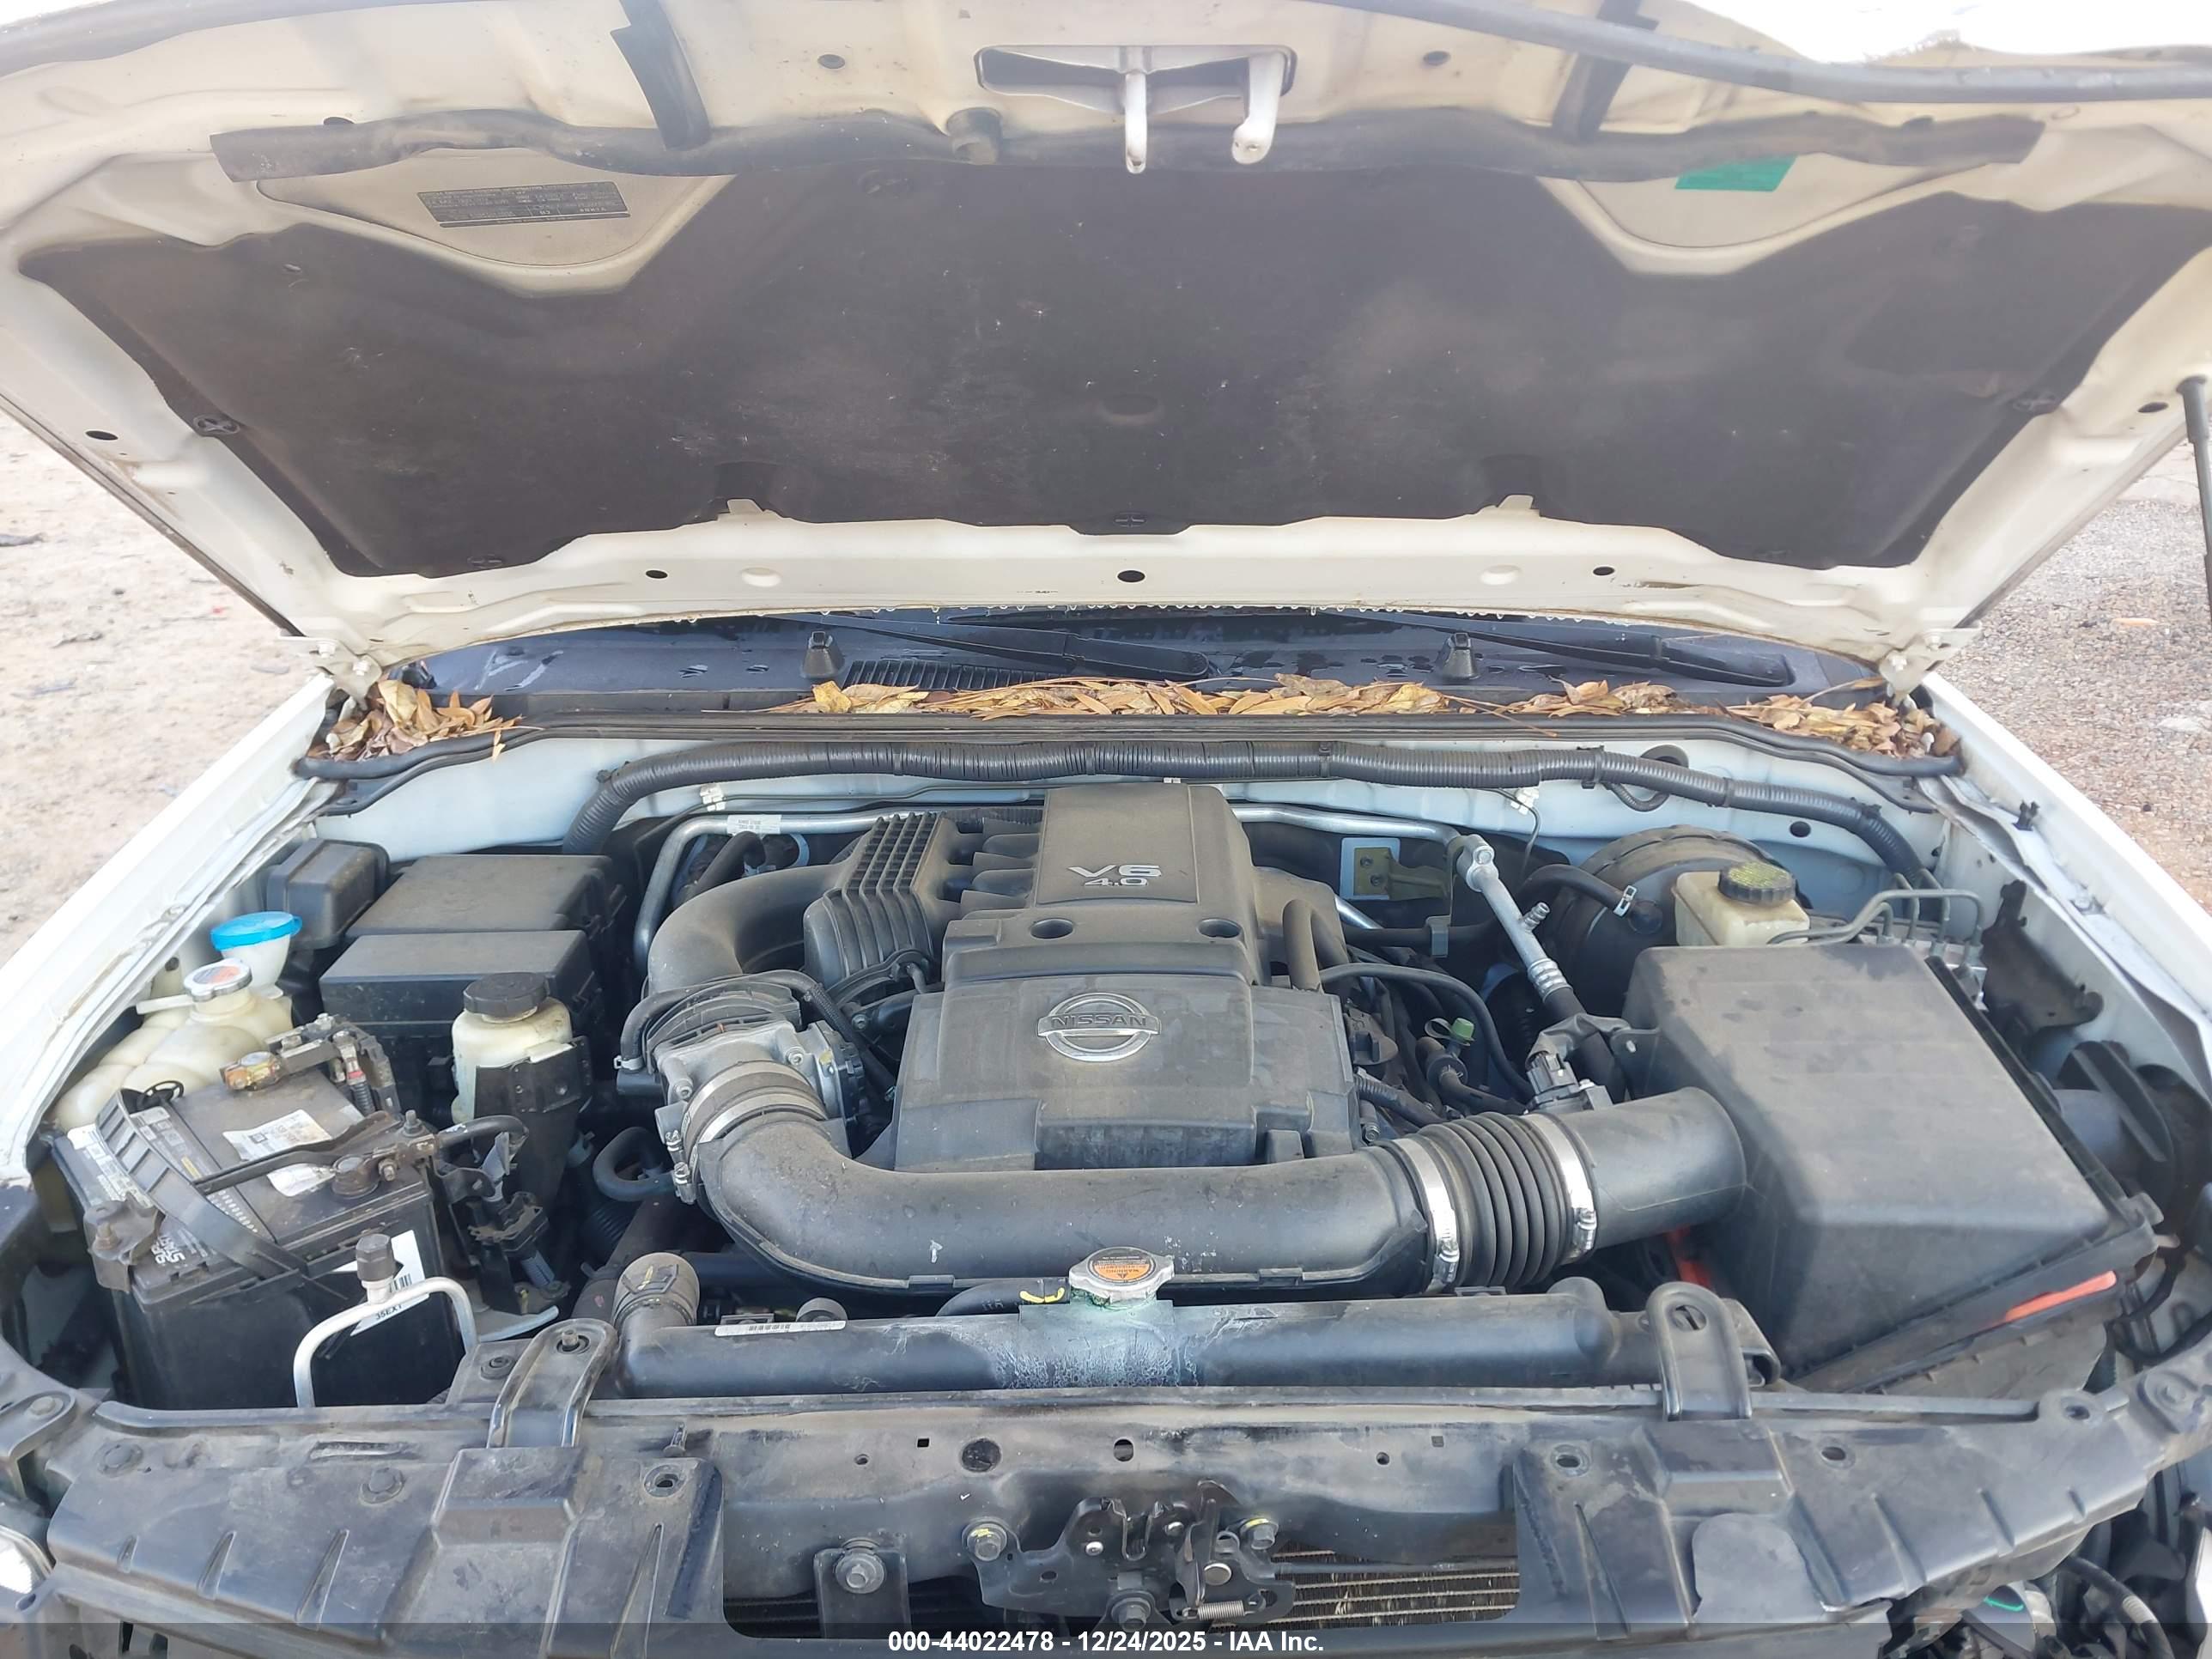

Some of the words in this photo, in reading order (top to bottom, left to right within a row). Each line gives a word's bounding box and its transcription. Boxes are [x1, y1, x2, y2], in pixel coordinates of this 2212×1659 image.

[1067, 864, 1162, 877] V6
[1085, 877, 1148, 886] 4.0
[1051, 1013, 1146, 1027] NISSAN
